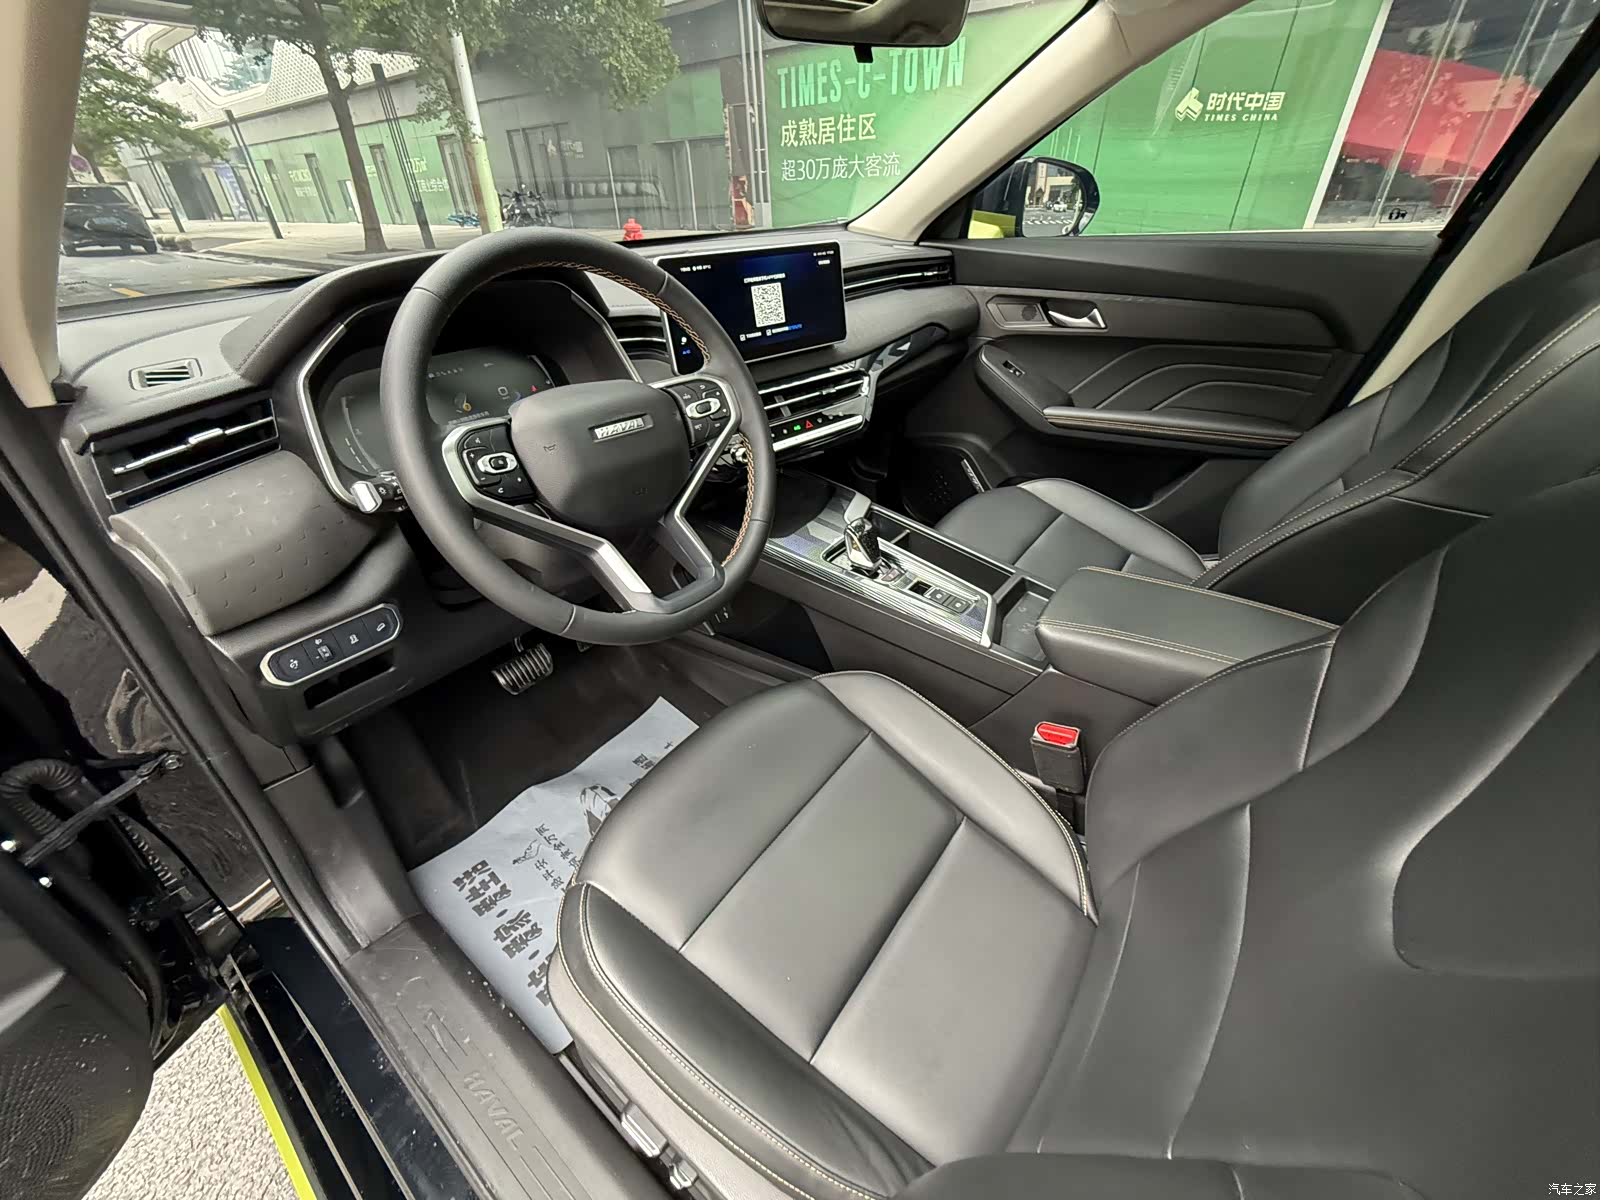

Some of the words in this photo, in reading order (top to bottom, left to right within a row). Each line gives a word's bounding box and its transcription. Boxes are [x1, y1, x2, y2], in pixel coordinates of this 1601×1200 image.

[1206, 91, 1286, 111] 时代中国
[780, 112, 877, 148] 成熟居住区
[1204, 113, 1237, 122] TIMES
[1242, 113, 1278, 121] CHINA
[781, 151, 901, 182] 超30万庞大客流
[599, 417, 644, 438] HAVAL
[463, 1070, 525, 1150] HAVAL
